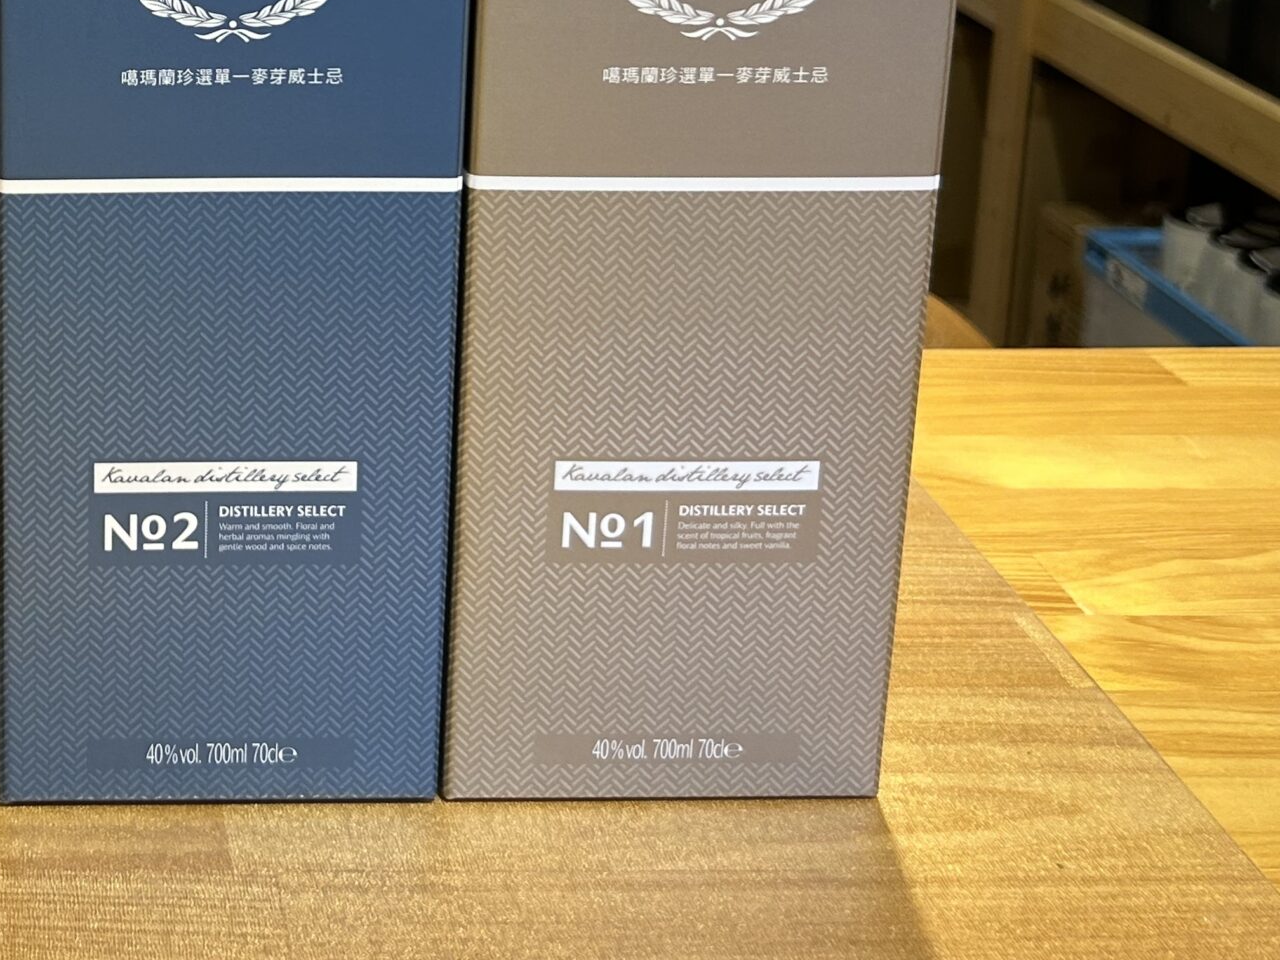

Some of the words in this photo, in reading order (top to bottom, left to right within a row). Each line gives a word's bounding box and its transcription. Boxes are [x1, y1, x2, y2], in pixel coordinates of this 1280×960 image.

[121, 67, 343, 86] 噶瑪蘭珍選單一麥芽威士忌
[602, 66, 829, 84] 噶瑪蘭珍選單一麥芽威士忌
[101, 466, 191, 483] Kavalan
[194, 465, 291, 489] distillery
[292, 465, 349, 483] select
[562, 464, 653, 482] Kavalan
[655, 465, 752, 489] distillery
[753, 464, 812, 482] select
[219, 505, 294, 517] DISTILLERY
[297, 505, 346, 517] SELECT
[679, 504, 754, 516] DISTILLERY
[757, 504, 806, 516] SELECT
[244, 522, 260, 531] and
[319, 522, 335, 531] and
[712, 521, 728, 530] and
[245, 542, 268, 551] wood
[269, 542, 285, 551] and
[206, 742, 248, 764] 700ml
[653, 738, 693, 759] 700ml
